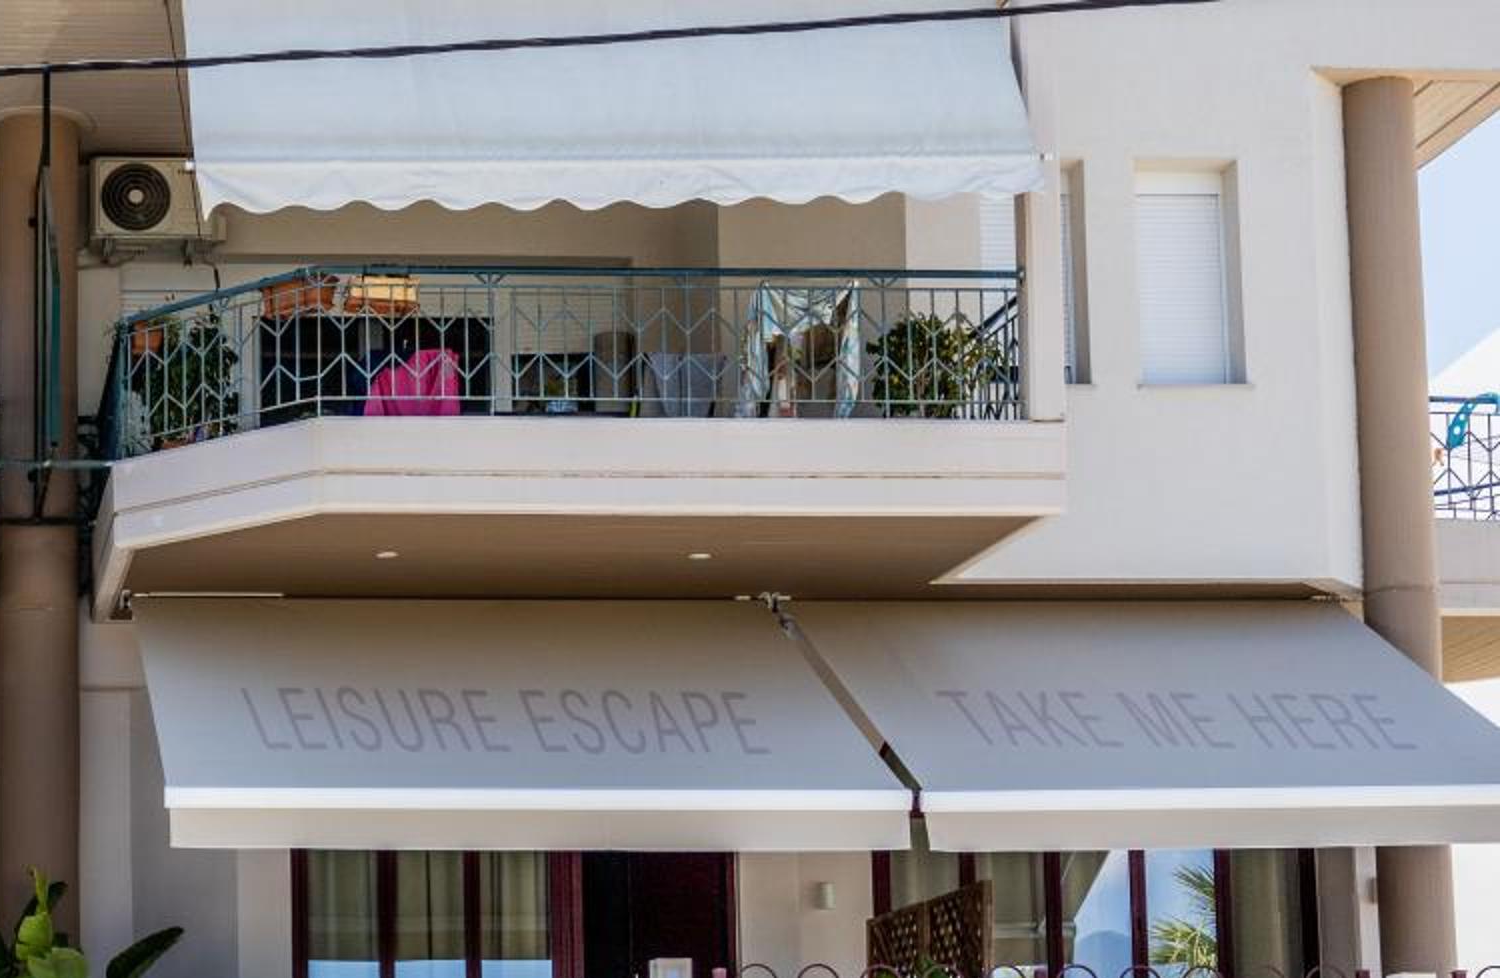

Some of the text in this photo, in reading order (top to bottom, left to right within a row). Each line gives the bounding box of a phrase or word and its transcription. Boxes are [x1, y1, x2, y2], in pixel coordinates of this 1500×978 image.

[242, 686, 770, 755] LEISURE ESCAPE
[935, 690, 1418, 751] TAKE ME HERE
